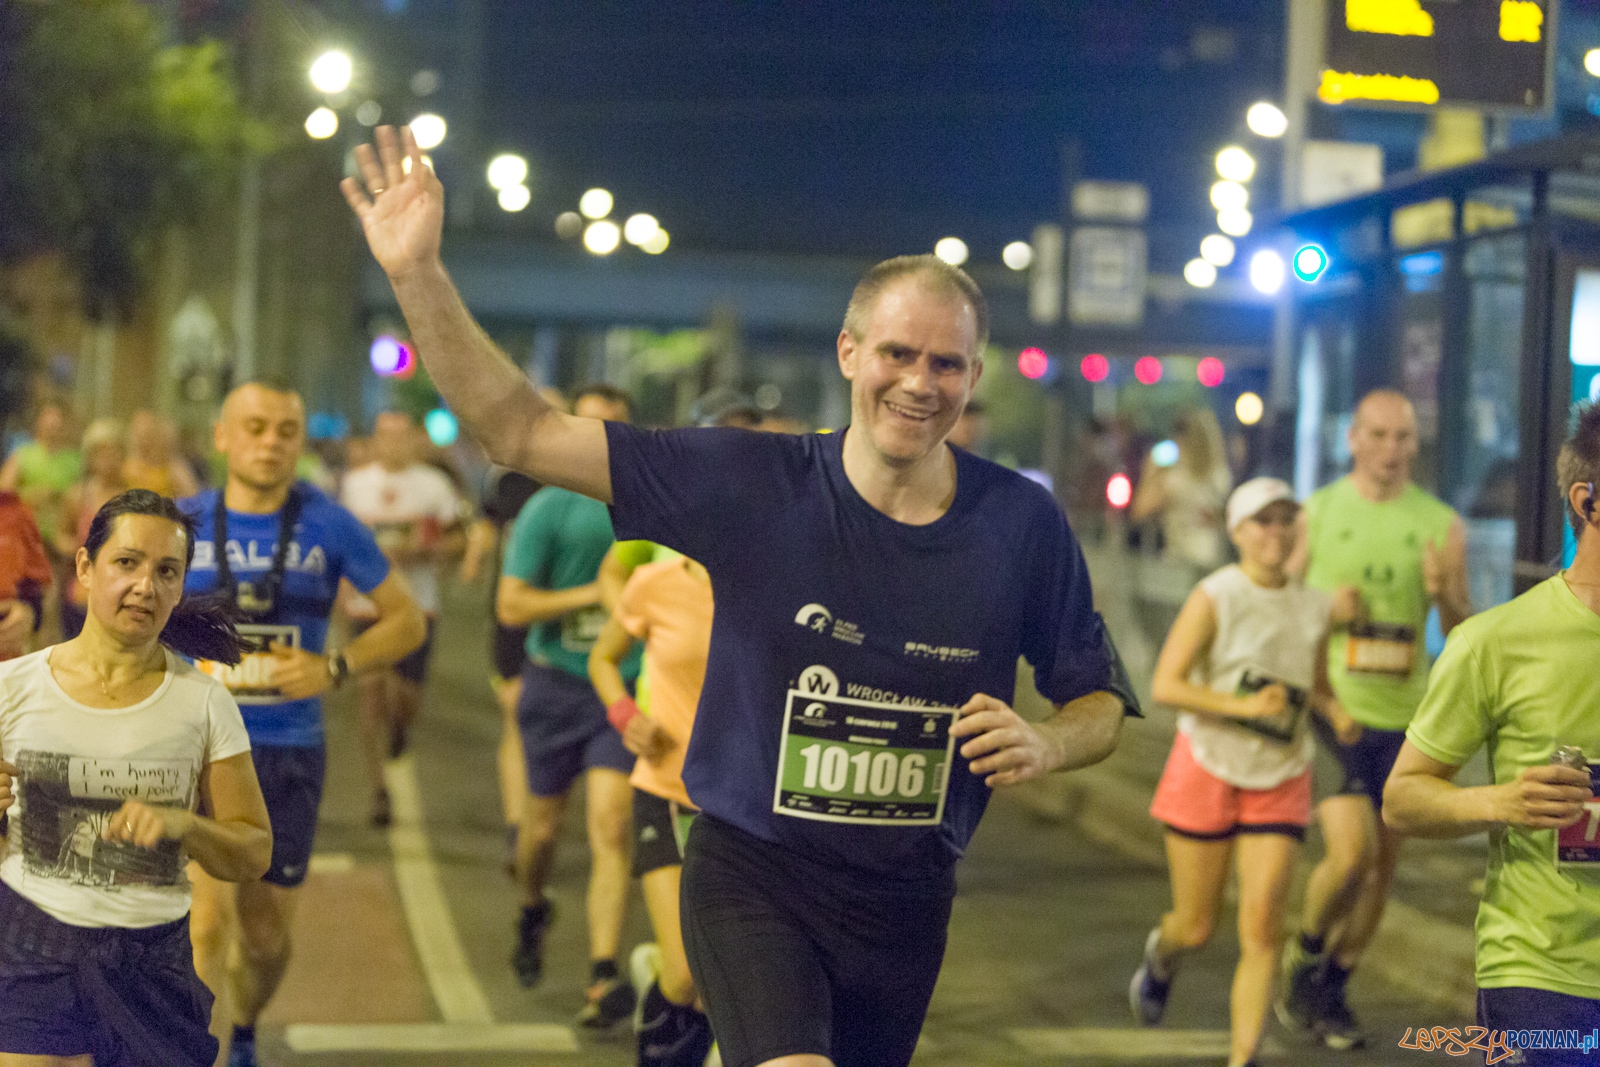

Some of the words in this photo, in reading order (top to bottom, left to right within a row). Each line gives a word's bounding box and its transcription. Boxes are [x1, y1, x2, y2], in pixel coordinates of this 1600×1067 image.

[127, 762, 180, 785] hungry
[800, 743, 927, 798] 10106
[103, 783, 139, 798] need
